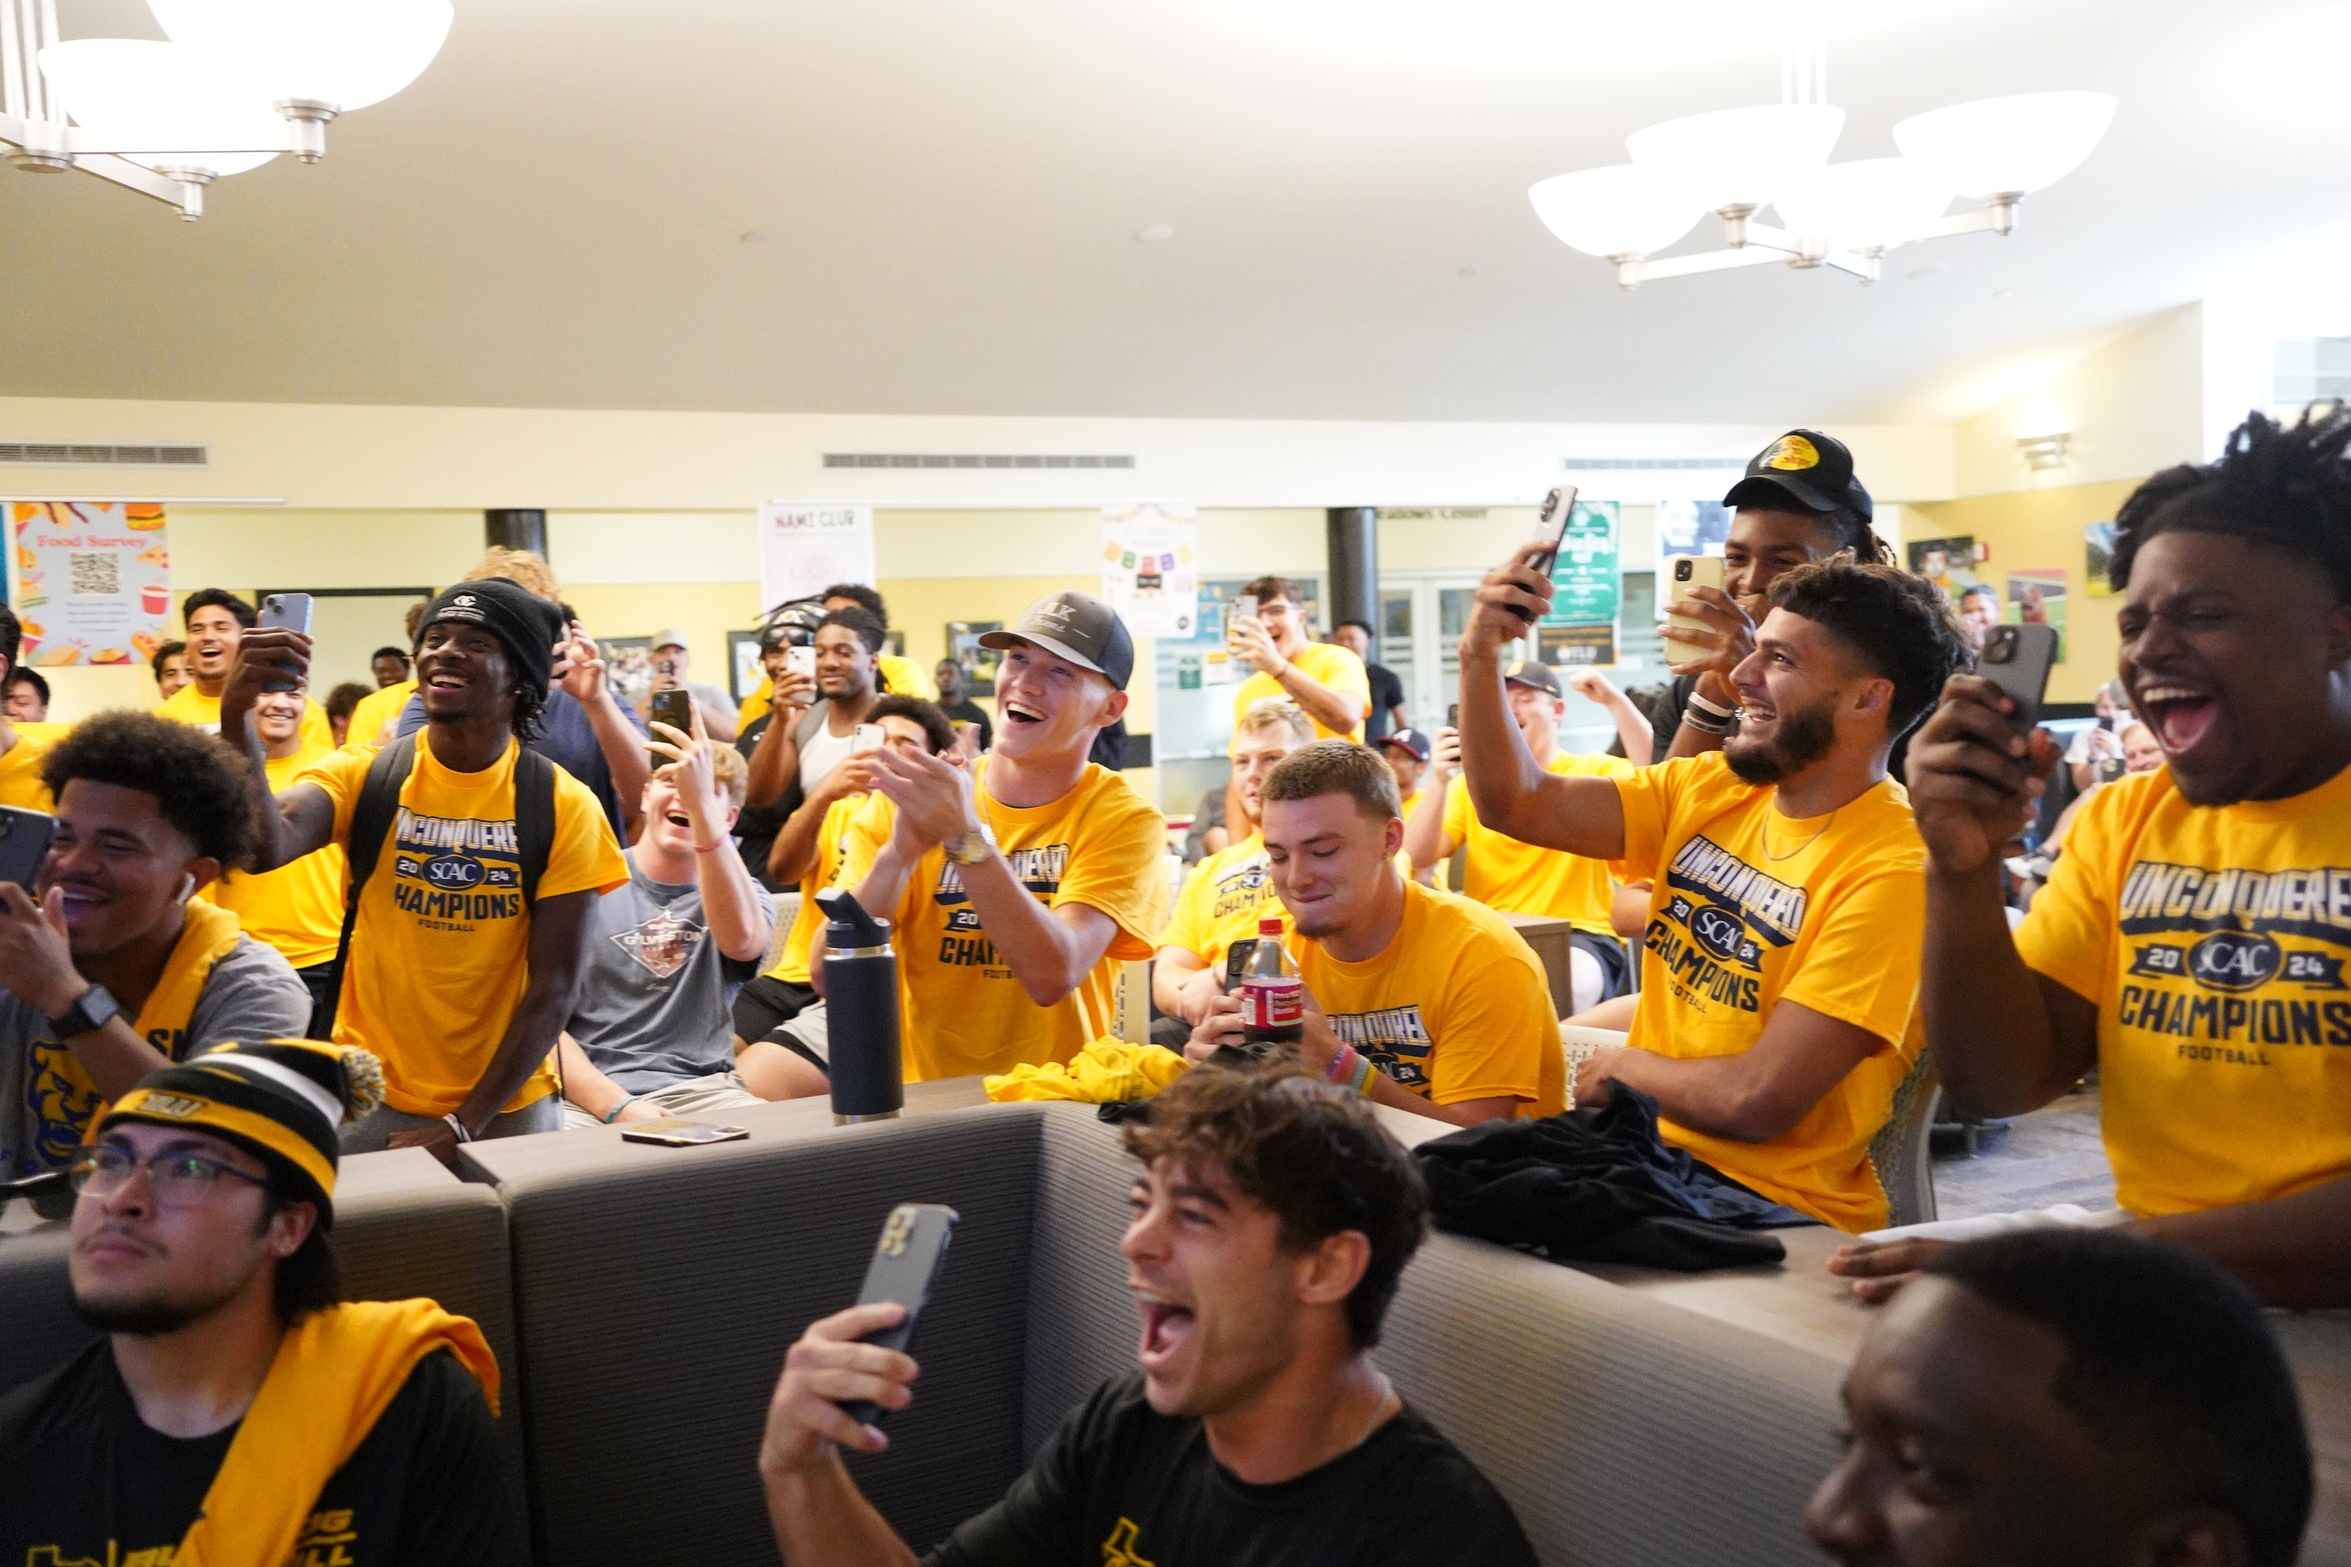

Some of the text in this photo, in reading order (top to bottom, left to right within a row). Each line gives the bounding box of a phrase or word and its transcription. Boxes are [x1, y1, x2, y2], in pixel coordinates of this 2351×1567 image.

[774, 508, 856, 529] NAMI CLUB
[36, 534, 148, 550] Food Survey
[1038, 602, 1078, 622] JLK
[398, 859, 510, 882] 20 SCAC 24
[395, 883, 520, 920] HAMPIONS
[418, 919, 475, 932] FOOTBALL
[957, 912, 979, 925] 20
[1672, 899, 1690, 919] 20
[1740, 943, 1756, 959] 24
[2147, 948, 2180, 969] 20
[2288, 955, 2325, 977] 24
[2178, 1045, 2270, 1066] FOOTBALL
[1399, 1066, 1416, 1079] 24
